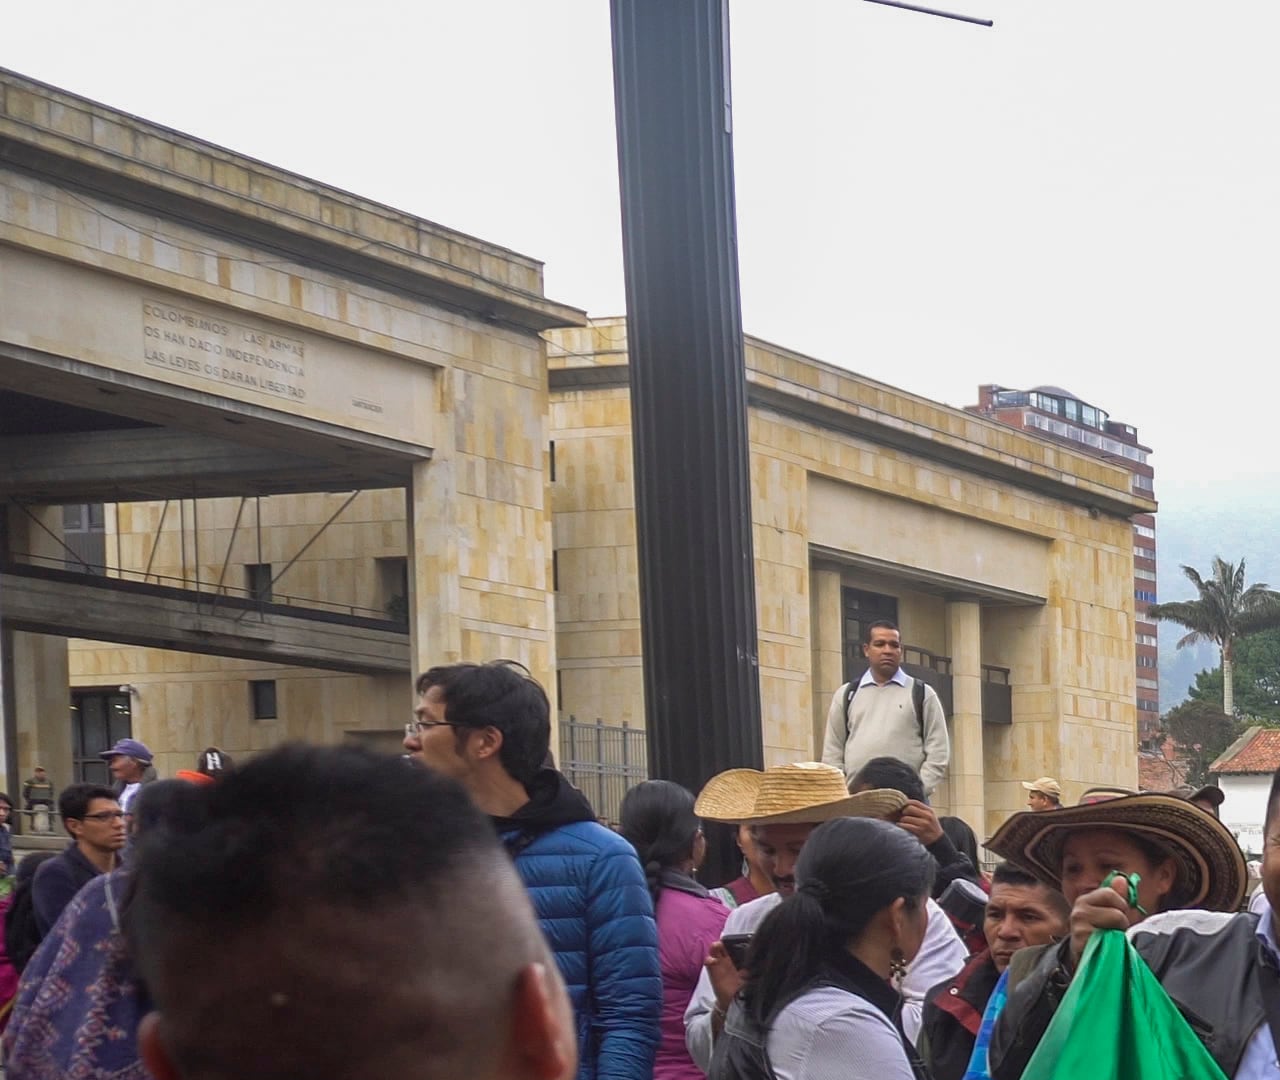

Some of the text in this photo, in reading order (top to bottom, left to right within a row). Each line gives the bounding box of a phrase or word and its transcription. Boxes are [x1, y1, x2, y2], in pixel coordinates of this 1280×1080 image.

[144, 326, 161, 340] OS
[188, 337, 222, 356] DADO
[225, 347, 305, 376] INDEPENDENCIA
[242, 331, 266, 346] LAS
[269, 339, 304, 357] ARMAS
[144, 348, 306, 399] LAS LEYES OS DARAN LIBERTAD
[206, 752, 223, 770] H
